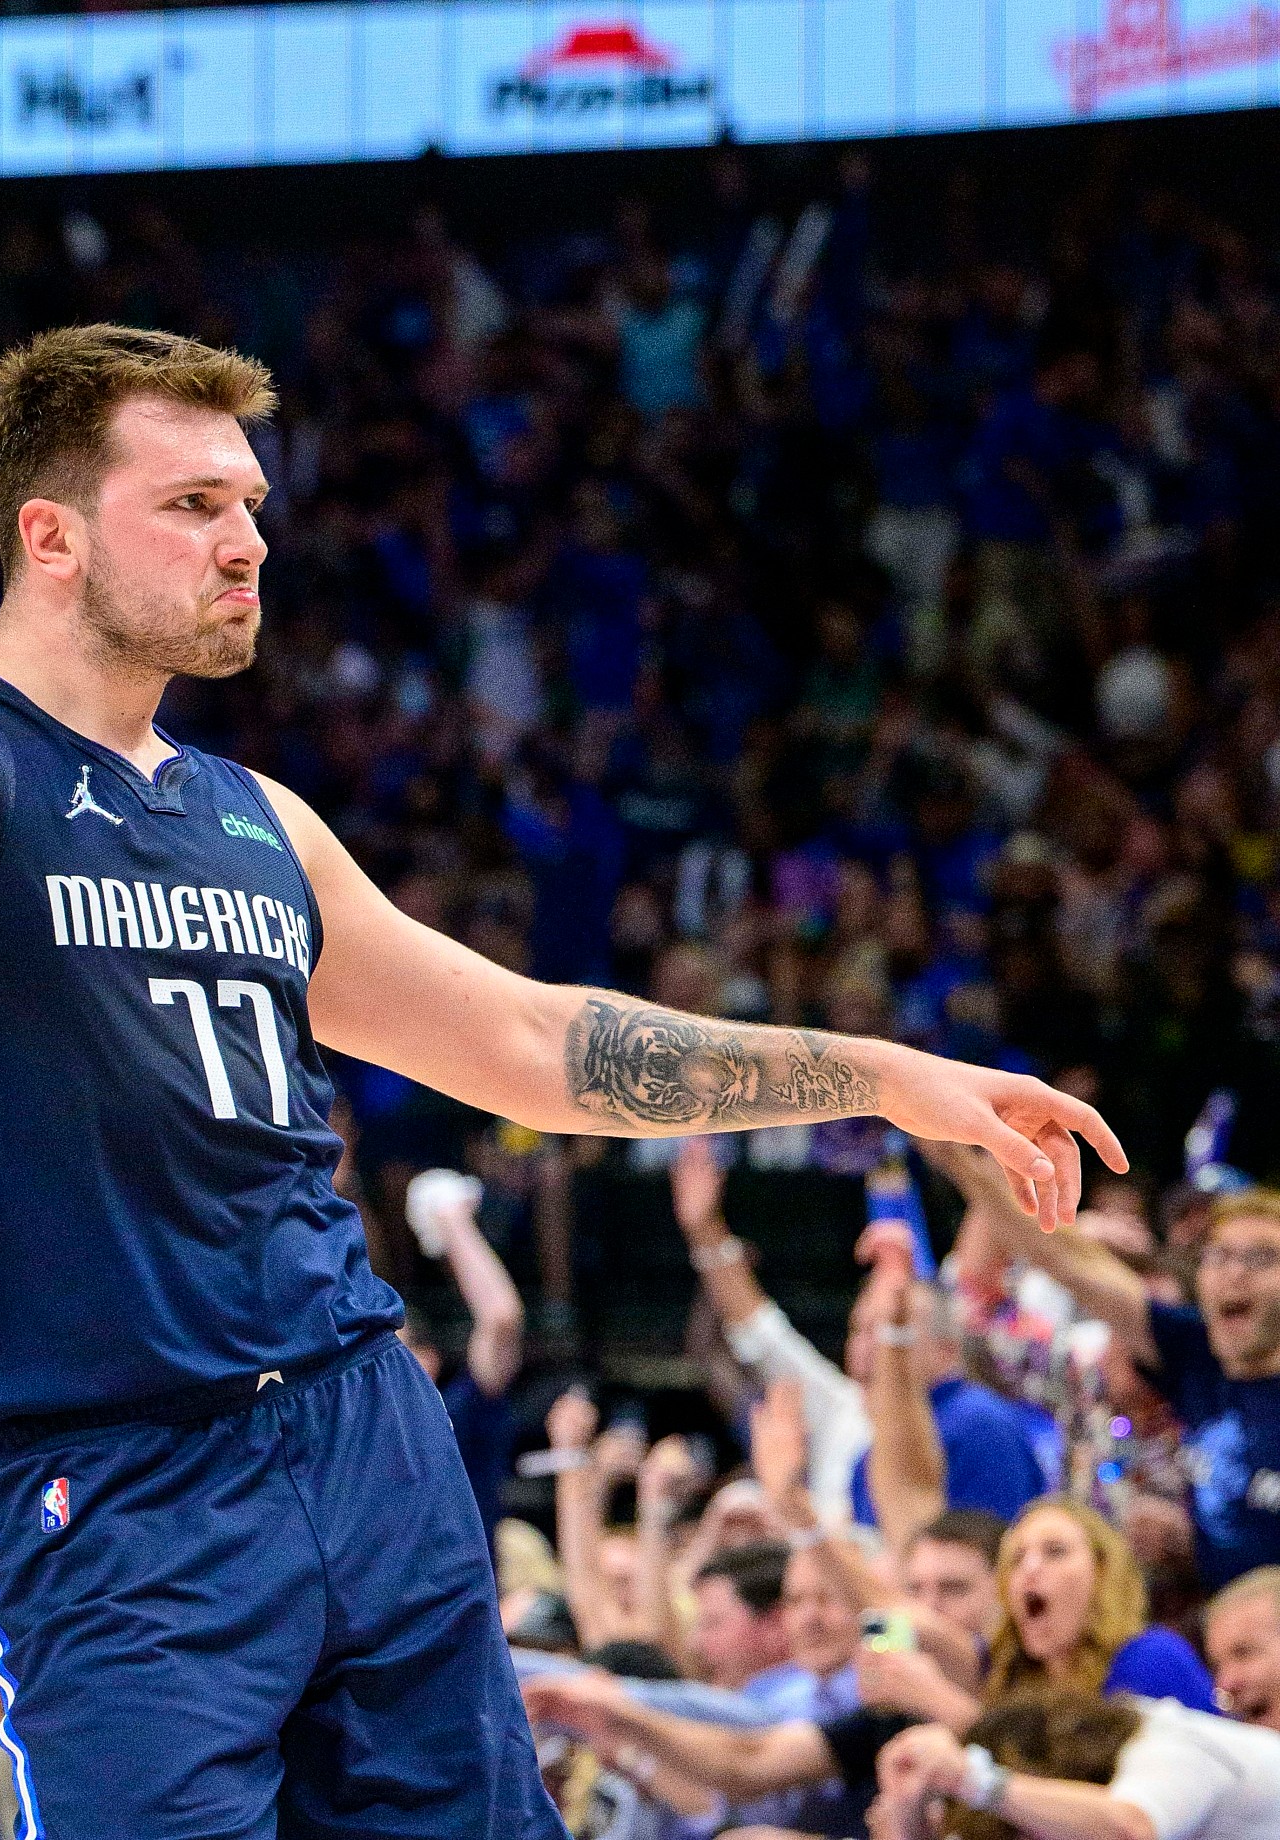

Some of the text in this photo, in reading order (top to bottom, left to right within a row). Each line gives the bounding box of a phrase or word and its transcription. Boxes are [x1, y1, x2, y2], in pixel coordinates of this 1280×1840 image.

[18, 66, 154, 130] Hut
[221, 813, 283, 852] chime
[45, 874, 310, 985] MAVERICKS
[147, 977, 290, 1128] 77
[45, 1515, 57, 1528] 75
